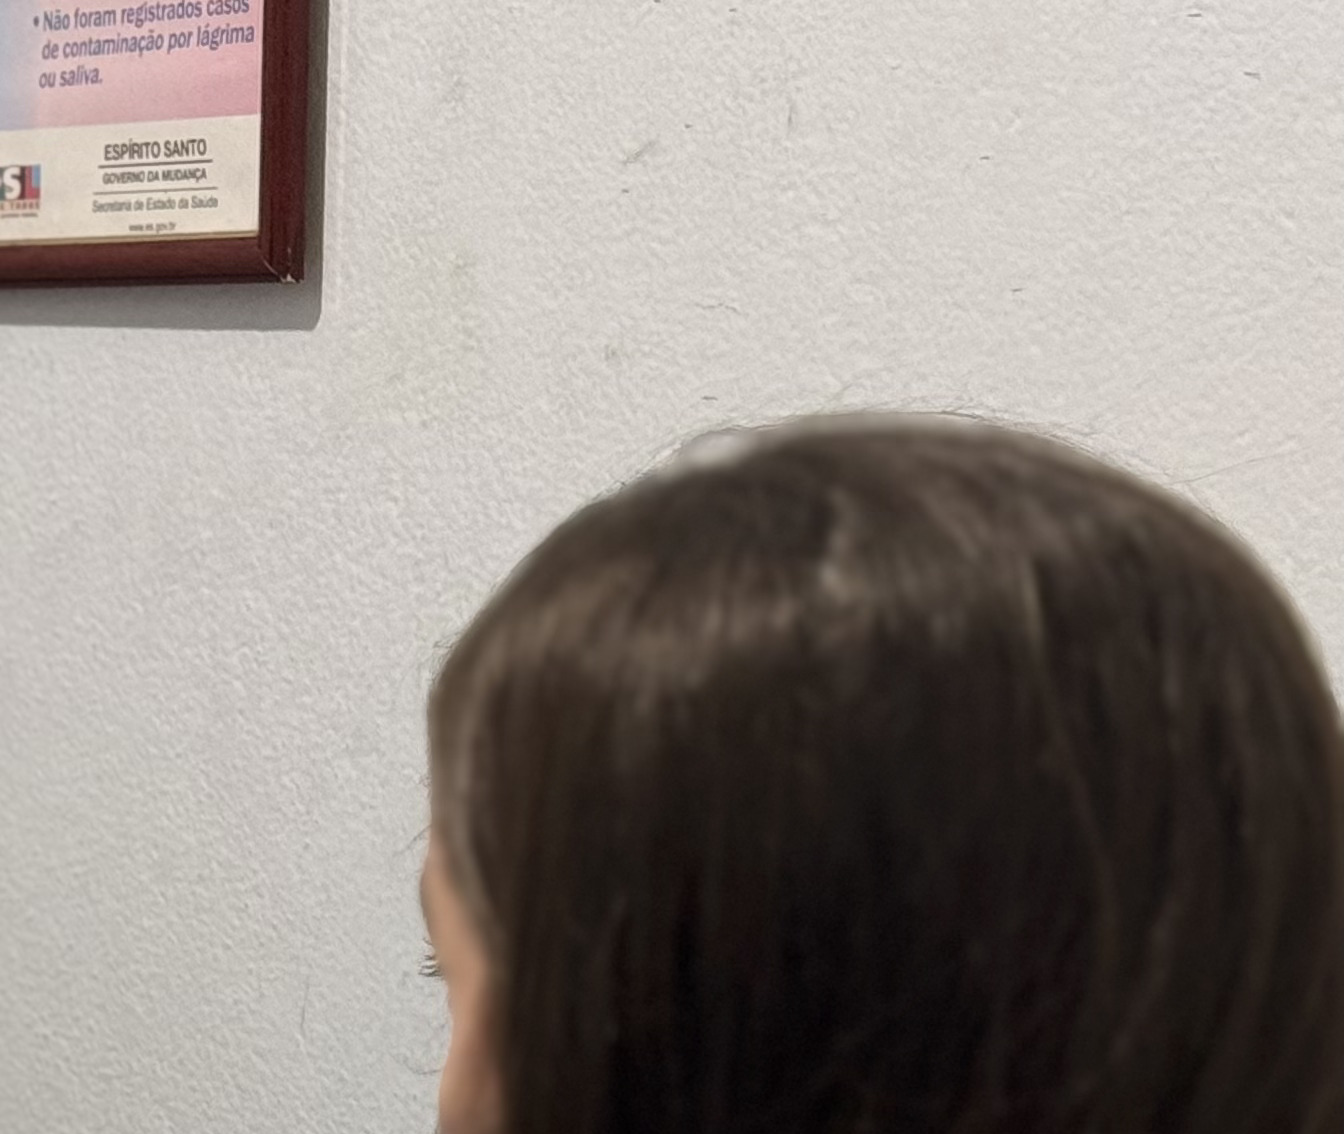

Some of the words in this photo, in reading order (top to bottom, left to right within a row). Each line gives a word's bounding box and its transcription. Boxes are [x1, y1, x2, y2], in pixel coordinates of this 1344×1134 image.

[42, 11, 70, 31] Não
[74, 7, 117, 29] foram
[120, 1, 202, 27] registrados
[206, 0, 250, 17] casos
[41, 40, 59, 60] de
[62, 30, 163, 58] contaminação
[167, 32, 193, 54] por
[196, 23, 255, 50] lágrima
[38, 72, 56, 89] ou
[59, 65, 103, 88] saliva.
[104, 138, 161, 161] ESPÍRITO
[163, 138, 207, 158] SANTO
[102, 171, 145, 185] GOVERNO
[147, 170, 160, 182] DA
[162, 168, 207, 183] MUDANÇA
[92, 200, 132, 213] Secretaria
[133, 200, 144, 212] de
[146, 197, 176, 211] Estado
[178, 198, 189, 209] da
[191, 195, 218, 209] Saúde
